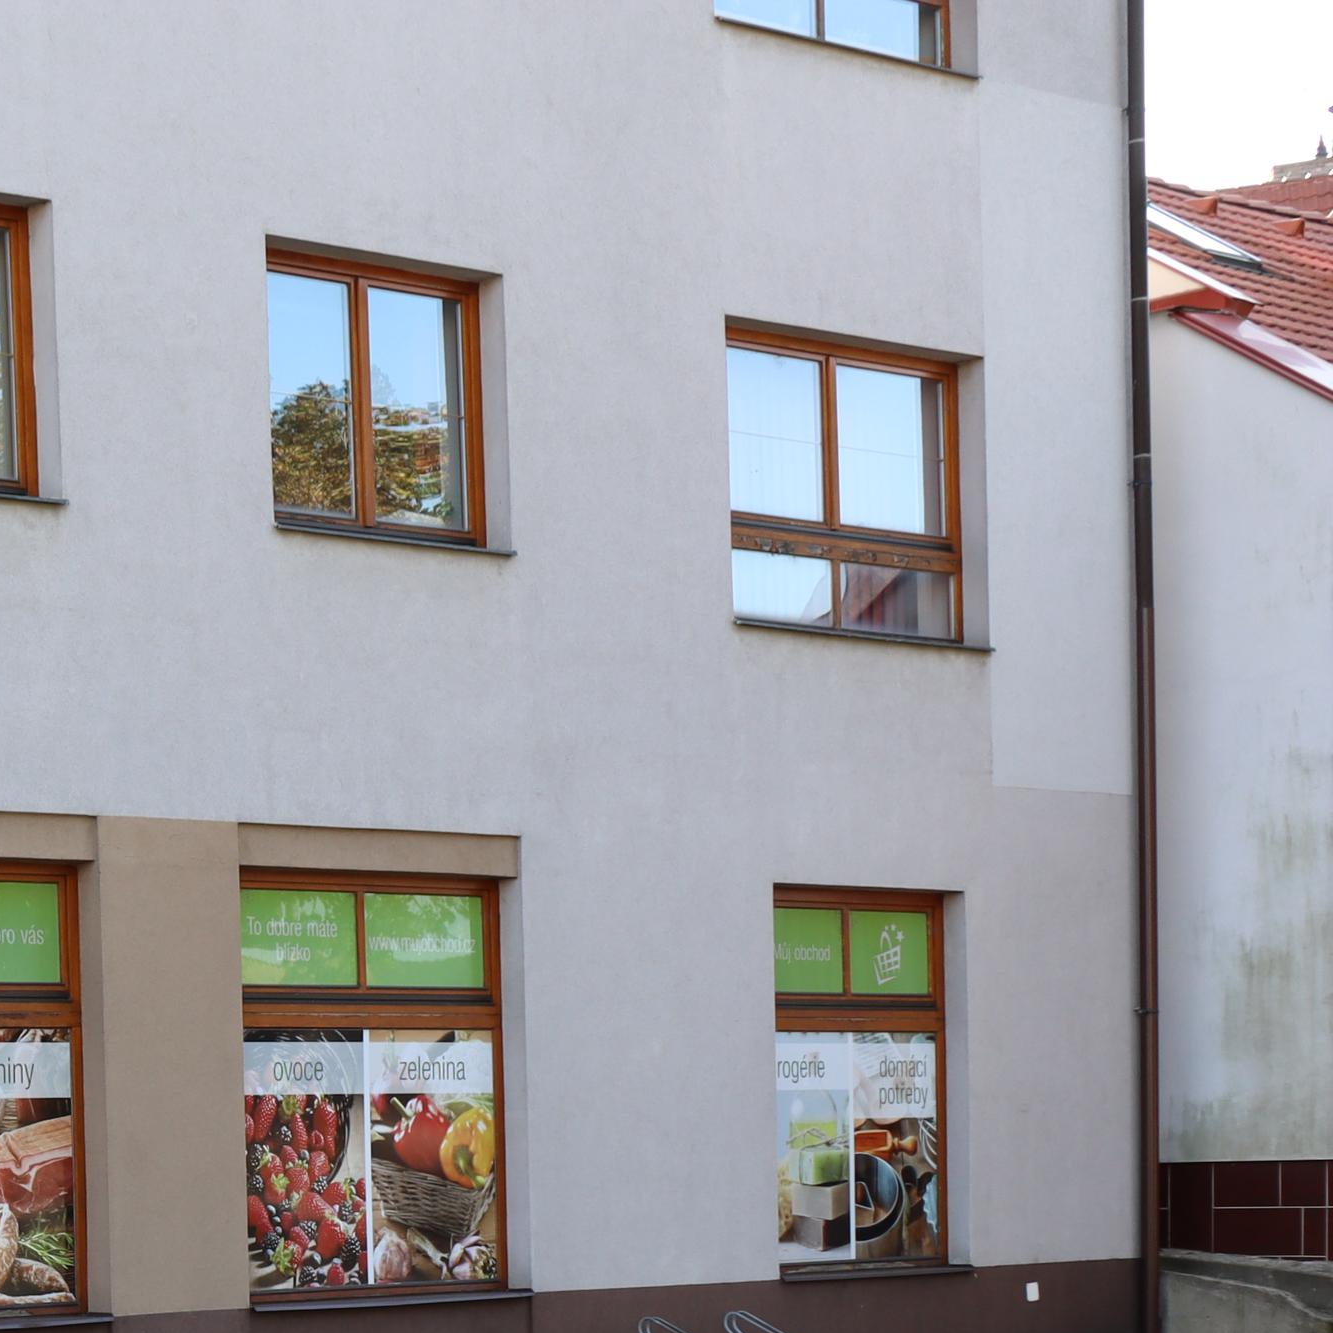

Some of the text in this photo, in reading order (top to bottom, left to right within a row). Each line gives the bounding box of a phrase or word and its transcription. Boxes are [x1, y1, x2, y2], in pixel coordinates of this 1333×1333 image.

[20, 924, 45, 945] vás
[247, 916, 262, 936] To
[794, 944, 830, 961] obchod
[273, 1061, 324, 1081] ovoce
[399, 1057, 466, 1081] zelenina
[777, 1055, 825, 1084] rogérie
[879, 1054, 927, 1078] domácí
[879, 1082, 928, 1109] potřeby
